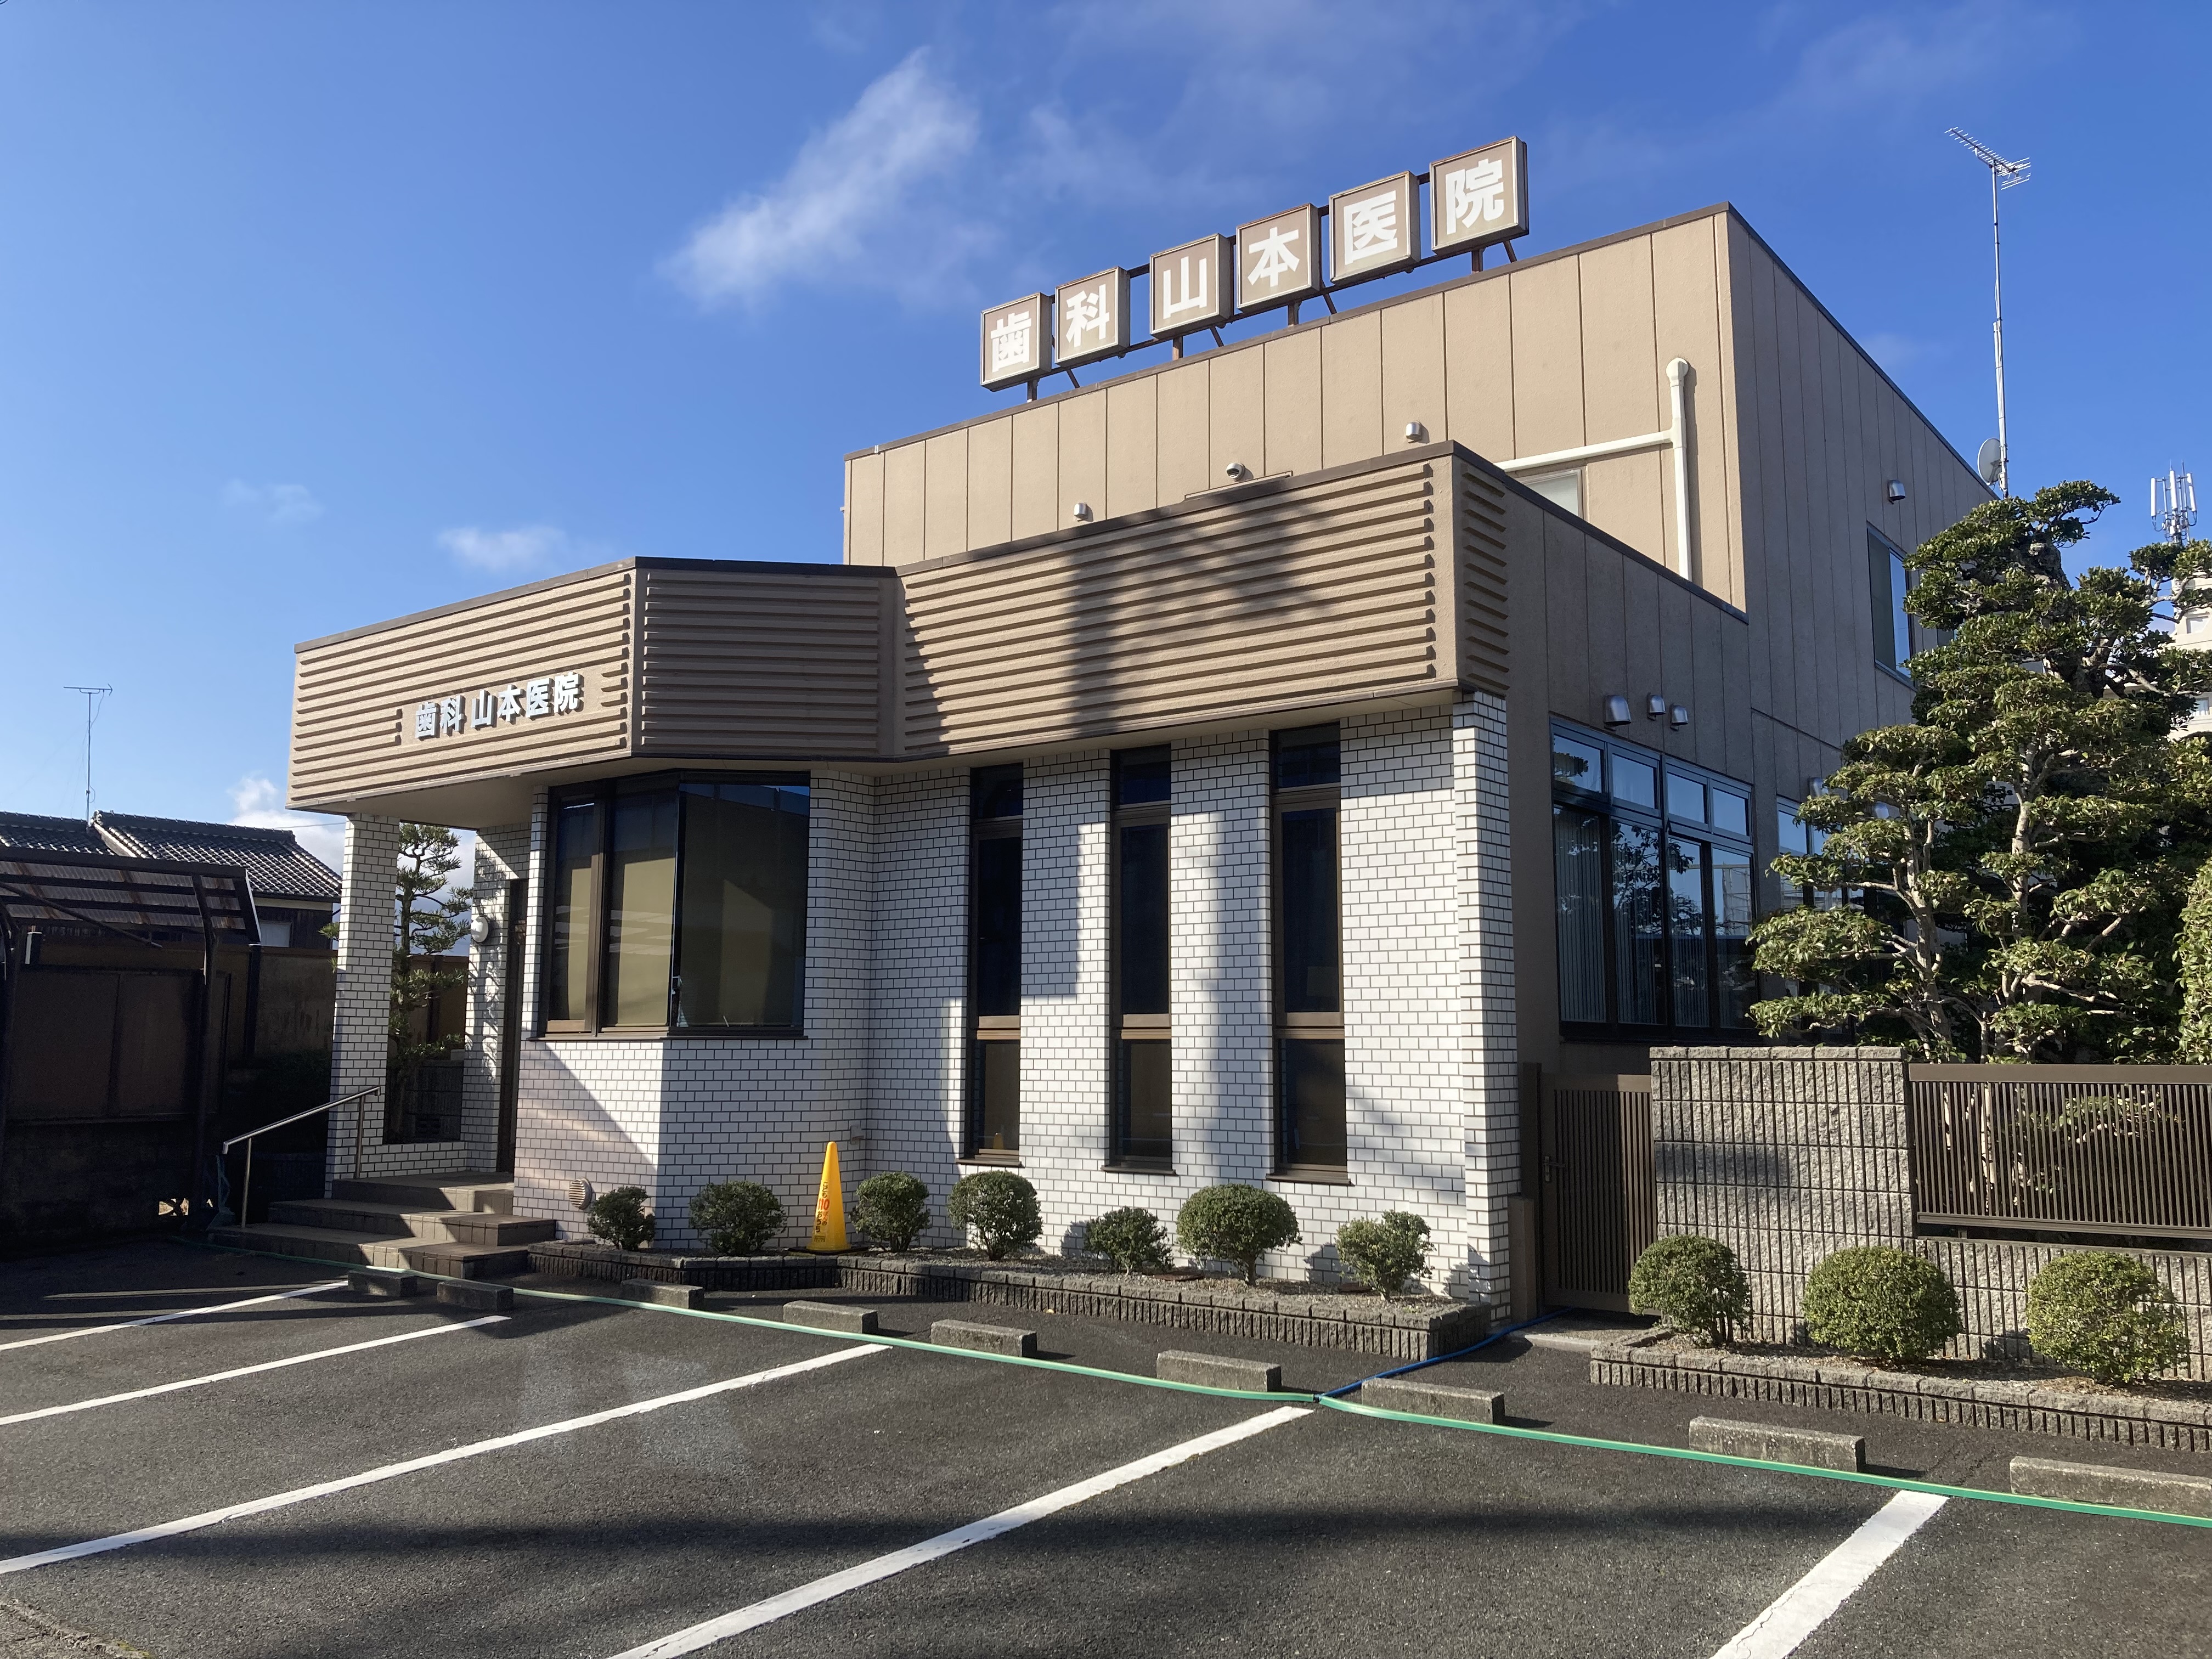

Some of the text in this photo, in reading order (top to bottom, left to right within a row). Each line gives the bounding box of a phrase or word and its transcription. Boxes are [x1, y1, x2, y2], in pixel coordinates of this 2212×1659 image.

[991, 158, 1505, 373] 歯科山本医院
[415, 672, 583, 738] 歯科山本医院
[818, 1198, 830, 1211] 110
